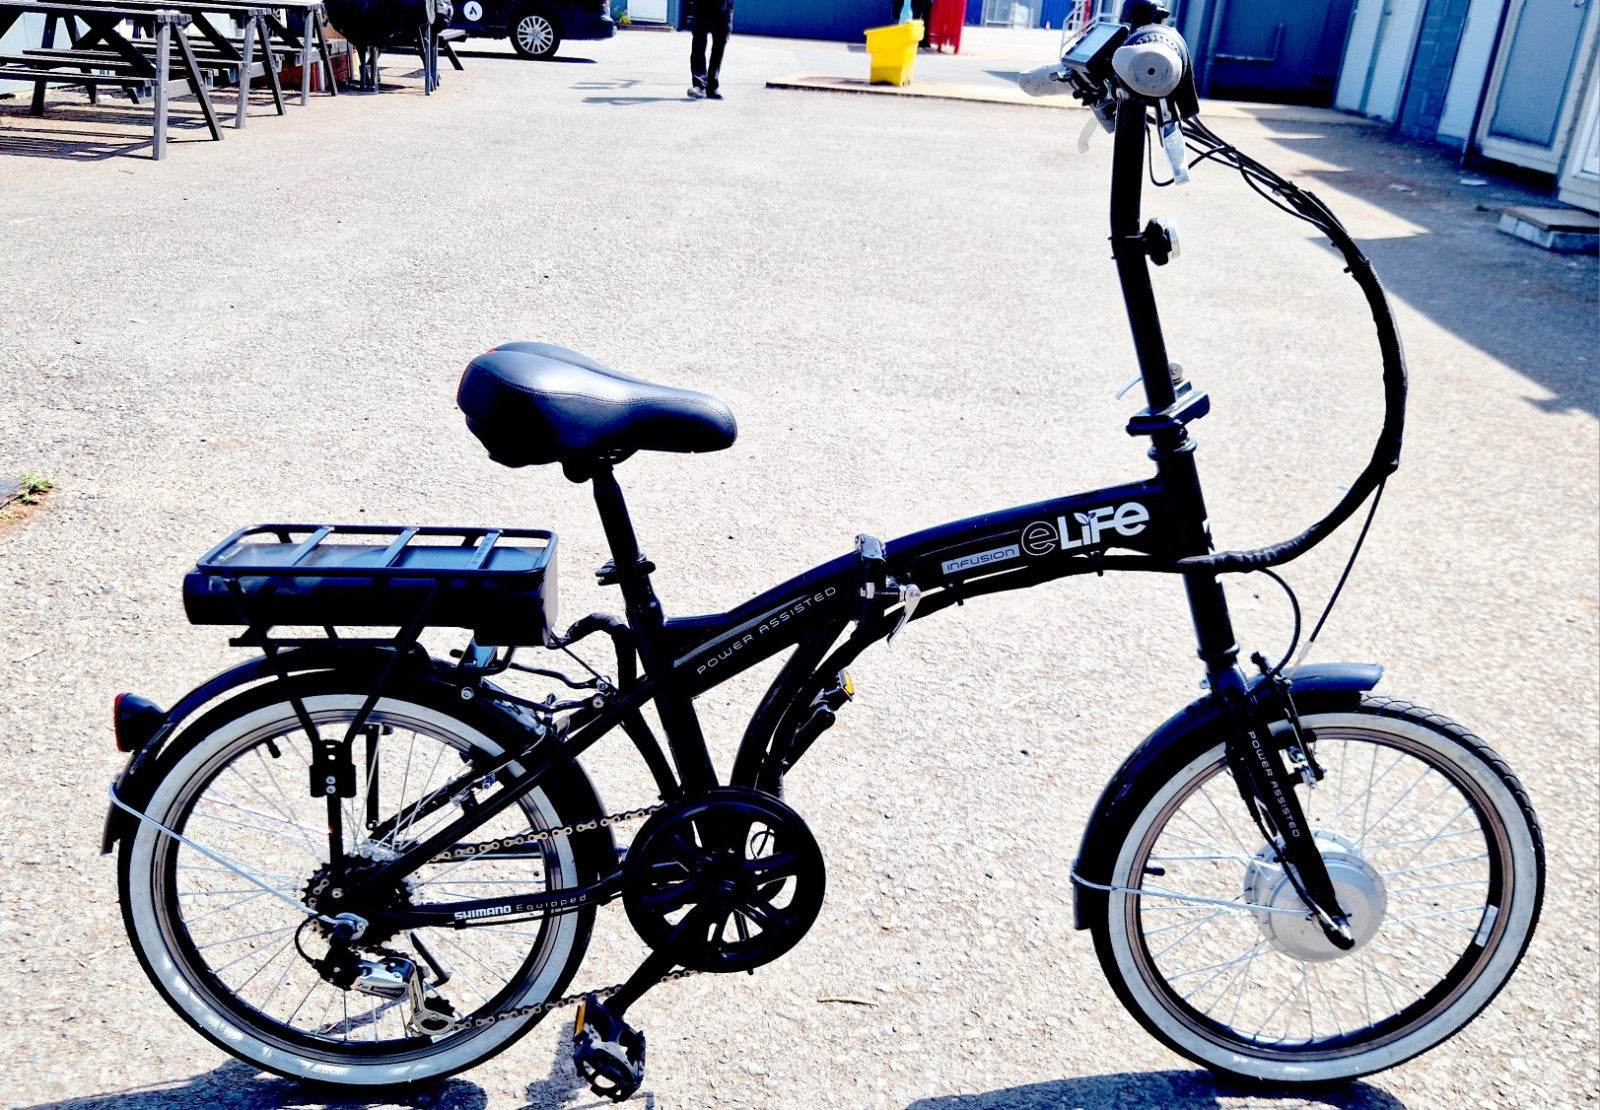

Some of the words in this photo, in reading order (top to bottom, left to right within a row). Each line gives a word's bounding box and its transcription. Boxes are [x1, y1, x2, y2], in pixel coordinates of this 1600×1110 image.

[696, 634, 754, 676] POWER
[758, 586, 837, 635] ASSISTED
[1248, 730, 1274, 777] POWER
[1270, 780, 1301, 838] ASSISTED
[454, 905, 512, 921] SHIMANO
[516, 893, 587, 912] Equipped
